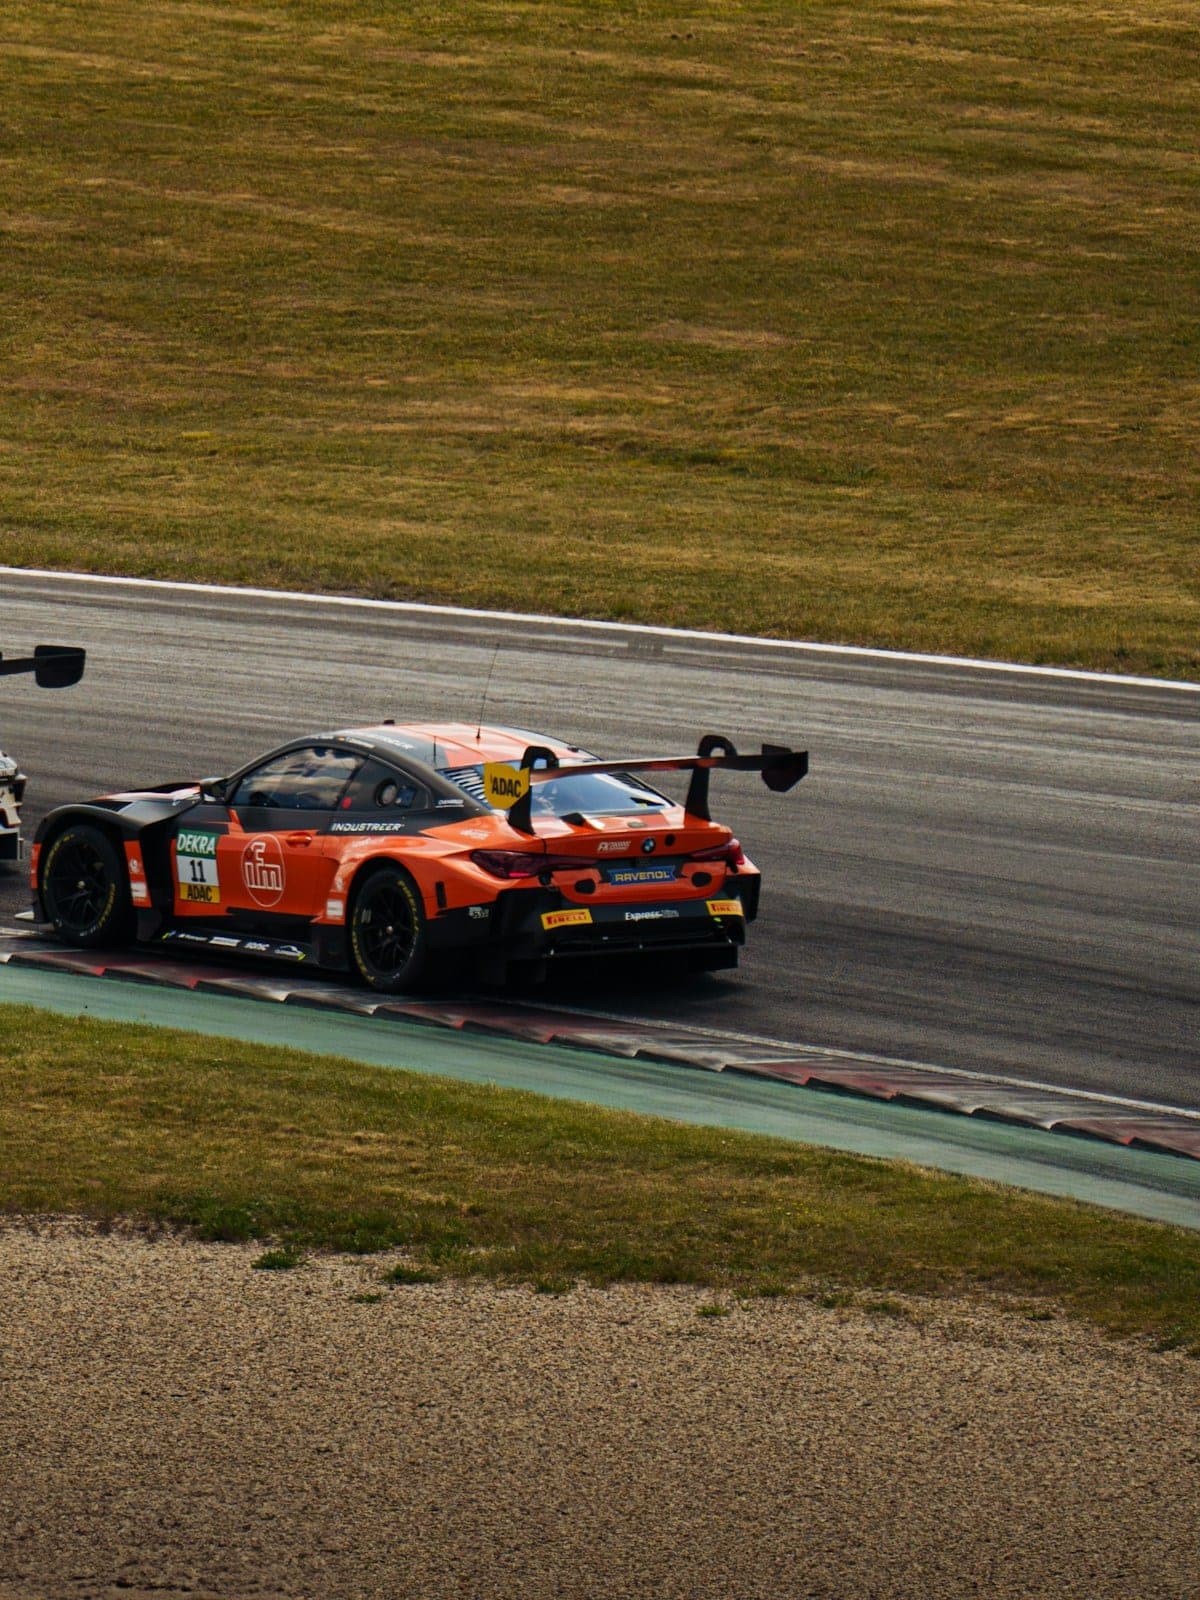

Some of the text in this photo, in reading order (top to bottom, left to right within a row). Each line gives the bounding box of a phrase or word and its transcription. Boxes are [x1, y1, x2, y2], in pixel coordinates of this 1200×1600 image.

[490, 777, 522, 797] ADAC
[177, 833, 215, 854] DEKRA
[190, 859, 206, 882] 11
[615, 871, 670, 882] RAVENOL
[187, 885, 212, 902] ADAC
[547, 911, 588, 925] PIRELLI
